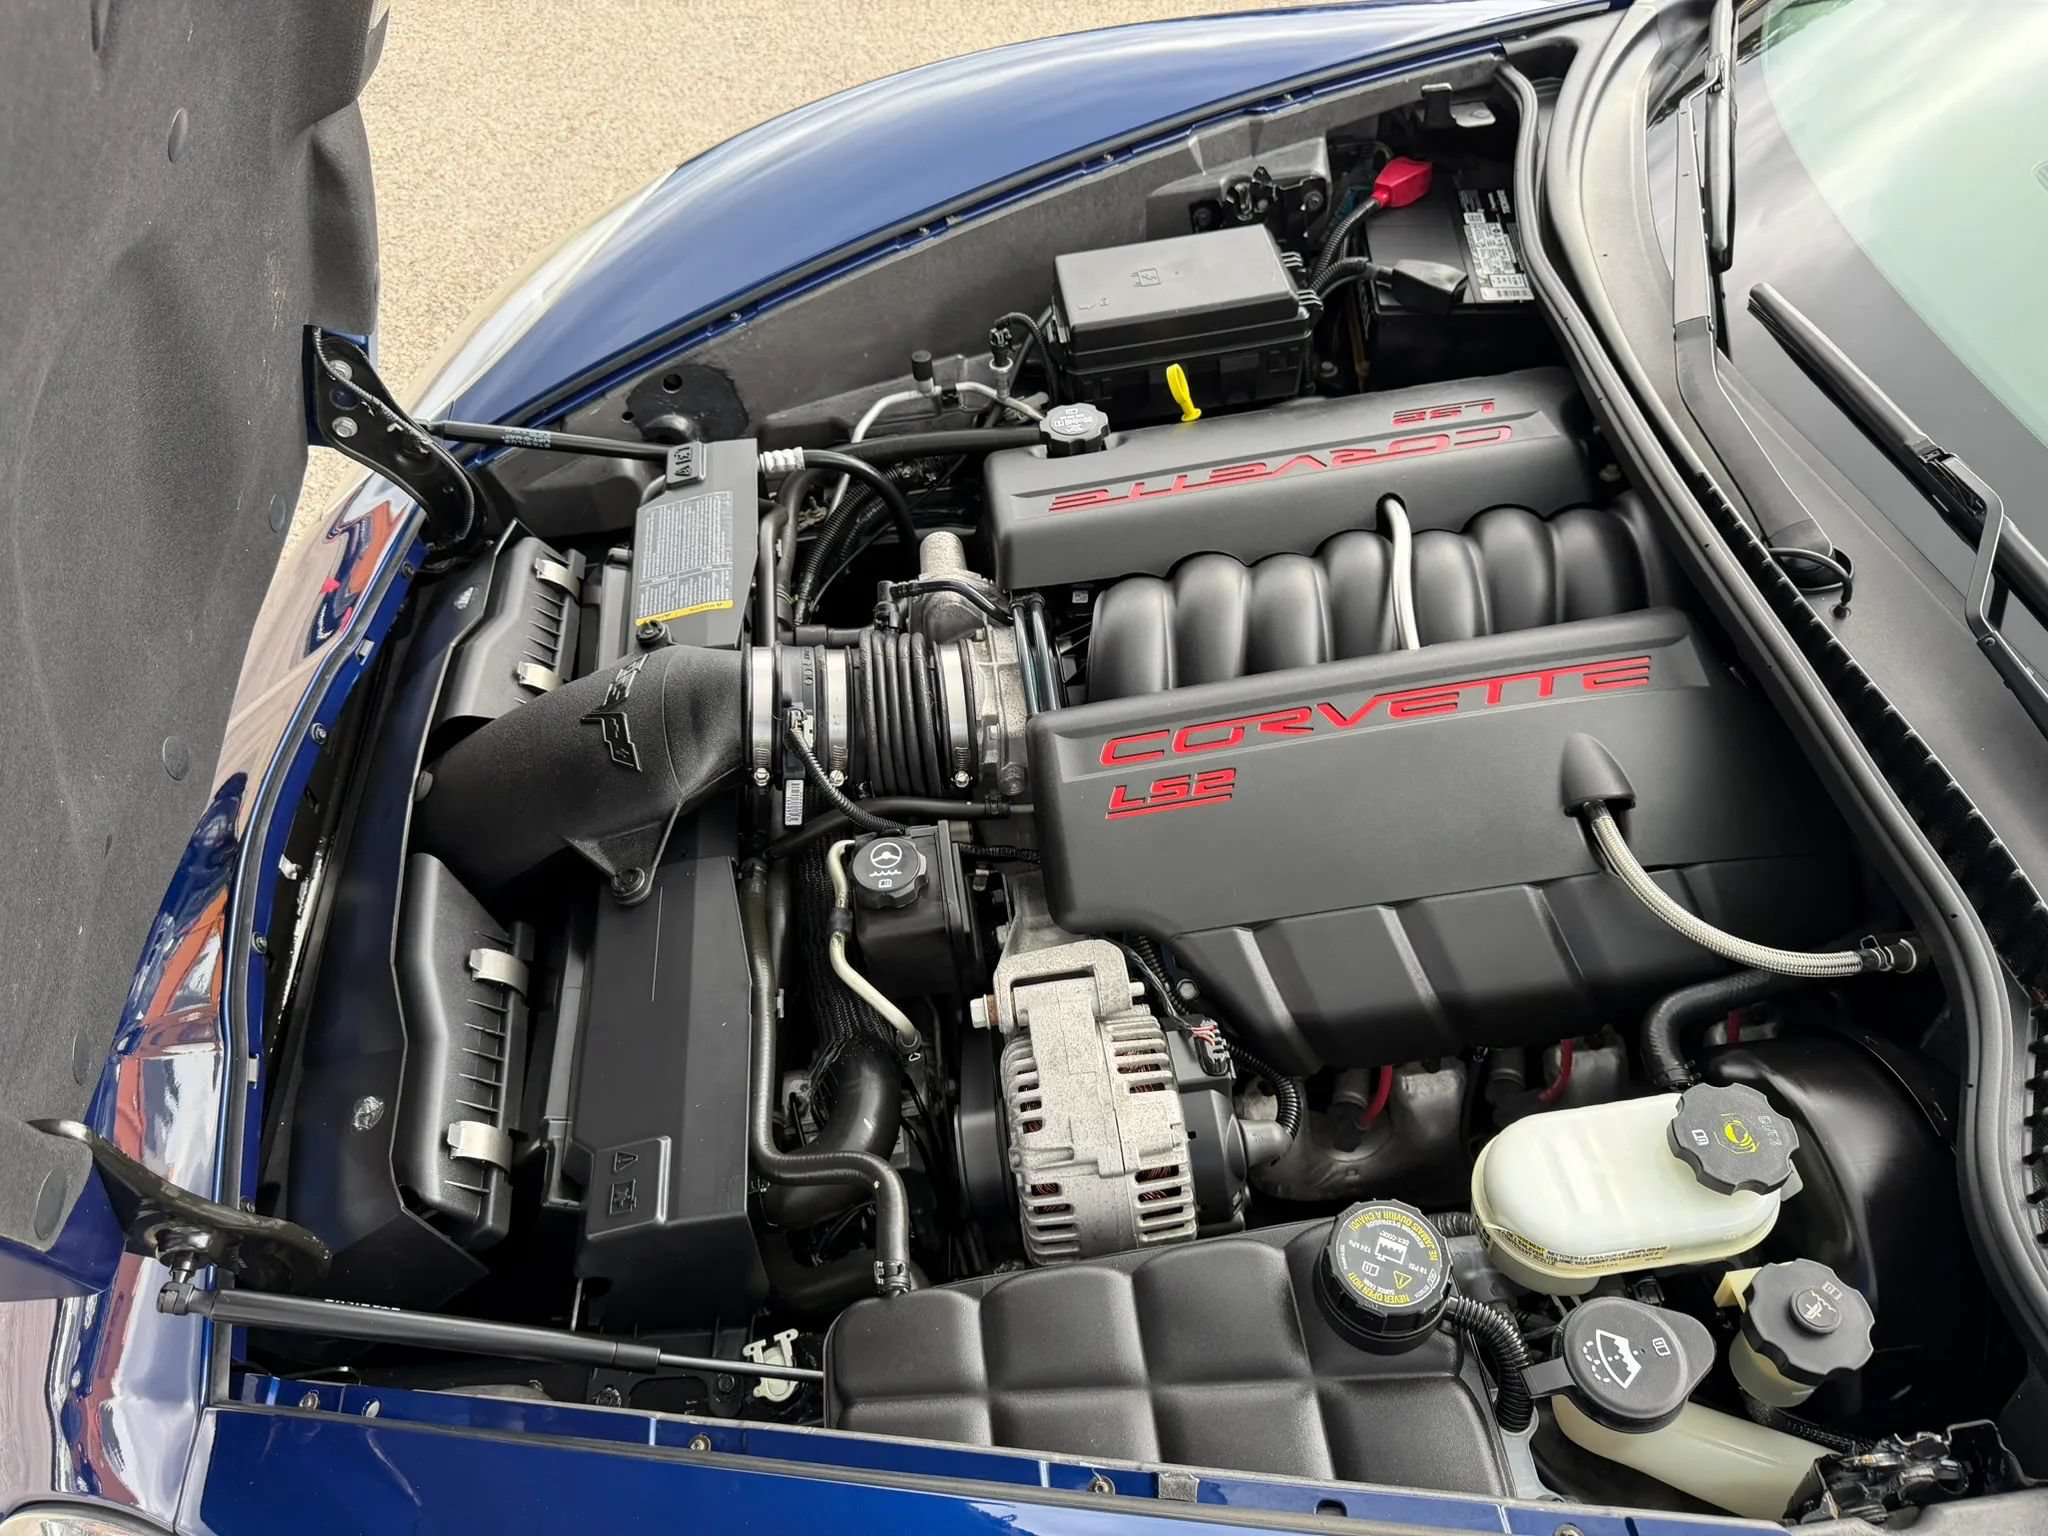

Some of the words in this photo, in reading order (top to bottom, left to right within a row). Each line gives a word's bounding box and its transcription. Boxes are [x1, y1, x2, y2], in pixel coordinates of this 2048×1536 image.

[1392, 399, 1495, 426] LS2
[1049, 425, 1512, 512] CORVETTE
[1100, 656, 1652, 767] CORVETTE
[1107, 768, 1236, 820] LS2
[1349, 1213, 1374, 1232] CHAUD!
[1383, 1211, 1412, 1225] OUVRIR
[1412, 1224, 1435, 1250] JAMAIS
[1429, 1250, 1438, 1261] NE
[1408, 1262, 1419, 1271] PSI
[1420, 1266, 1427, 1274] 18
[1362, 1285, 1383, 1301] OPEN
[1384, 1293, 1410, 1303] NEVER
